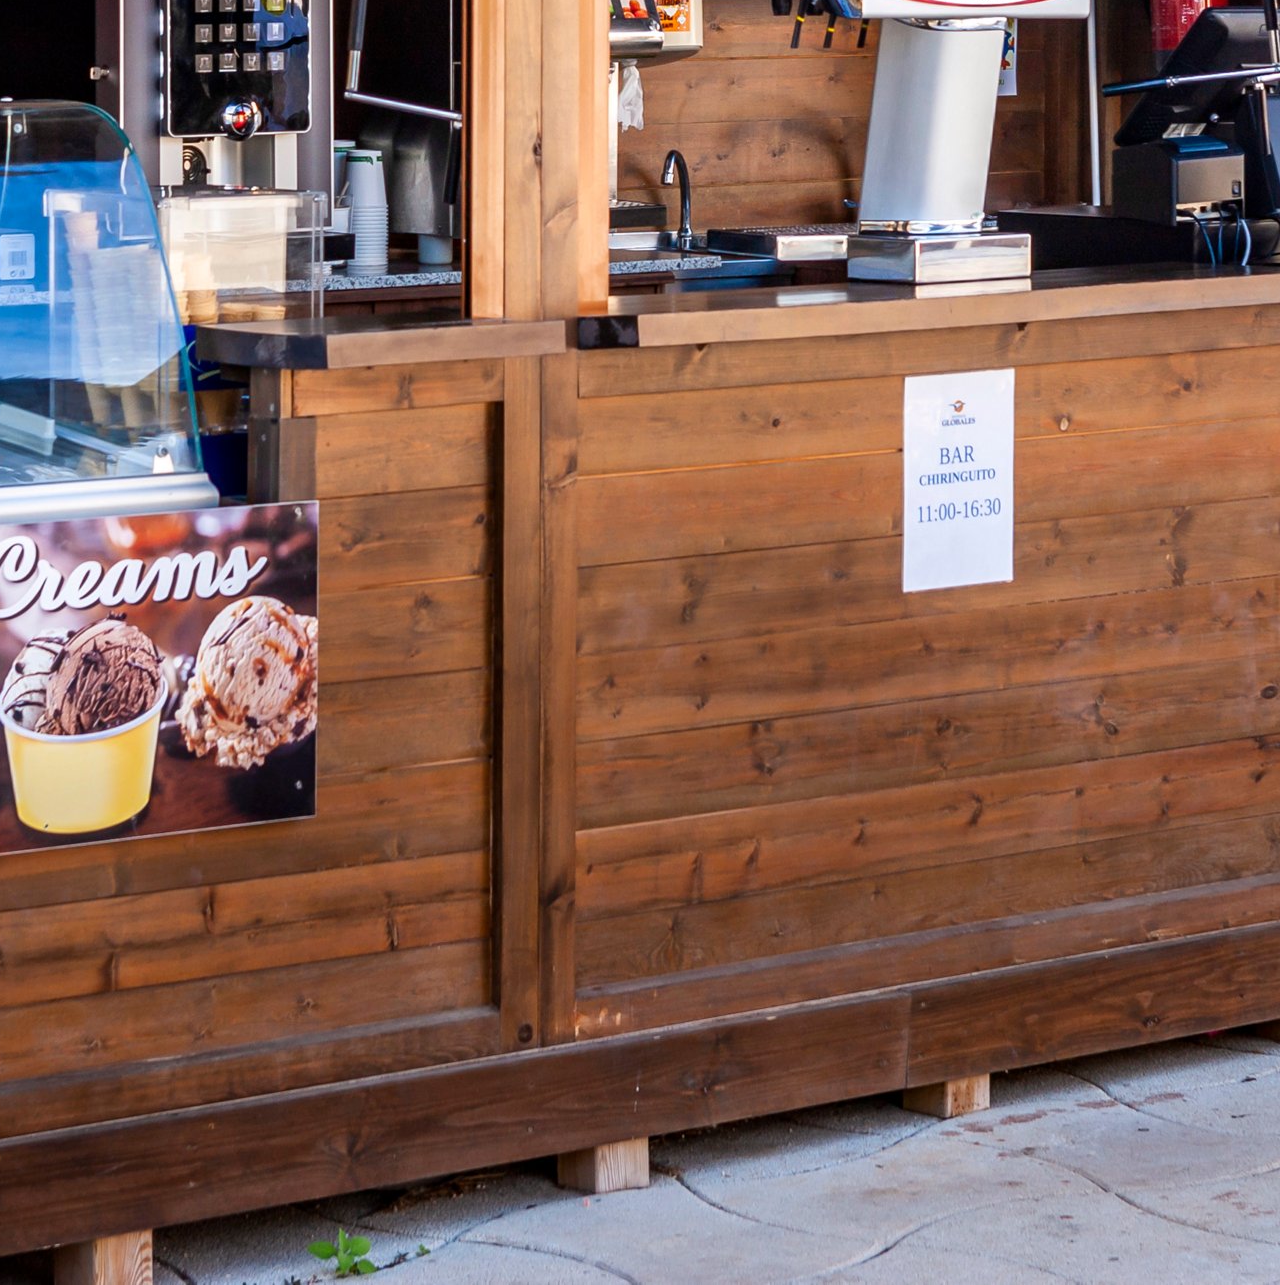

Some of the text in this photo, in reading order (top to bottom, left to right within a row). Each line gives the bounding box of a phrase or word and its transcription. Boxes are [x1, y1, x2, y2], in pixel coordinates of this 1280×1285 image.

[941, 417, 976, 427] GLOBALES
[939, 445, 975, 465] BAR
[919, 468, 996, 486] CHIRINGUITO
[917, 497, 1002, 523] 11:00-16:30
